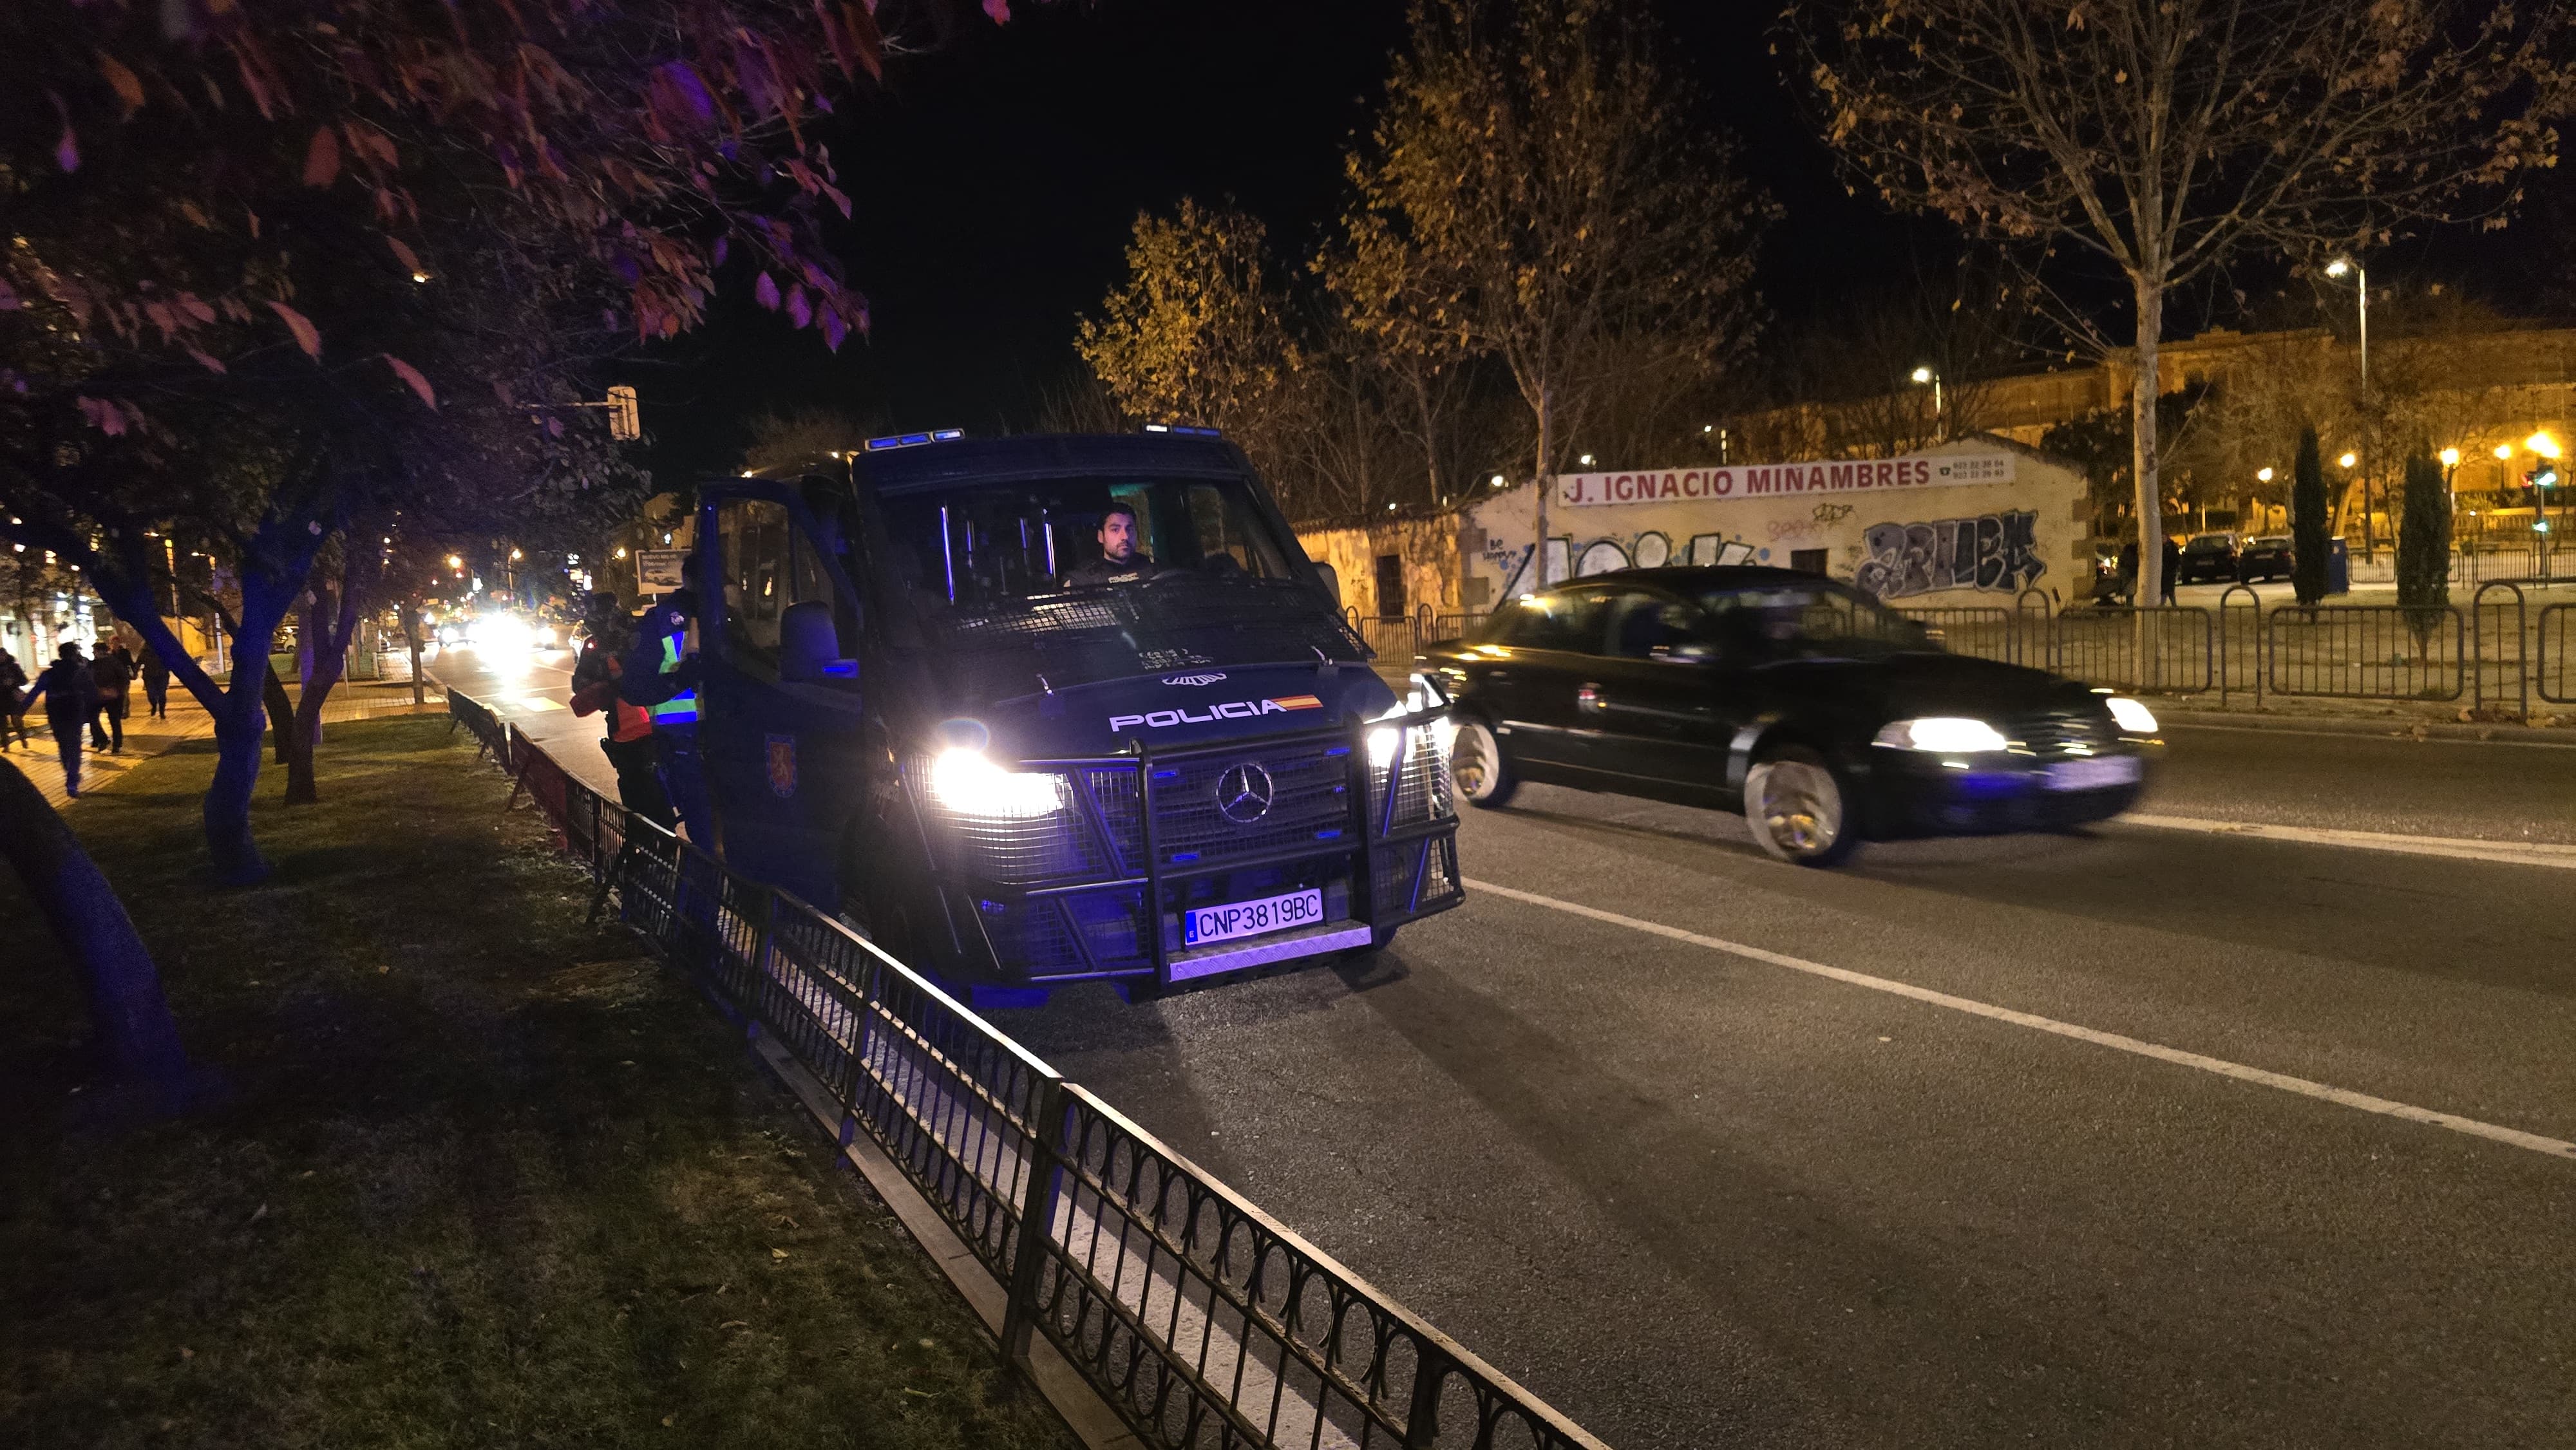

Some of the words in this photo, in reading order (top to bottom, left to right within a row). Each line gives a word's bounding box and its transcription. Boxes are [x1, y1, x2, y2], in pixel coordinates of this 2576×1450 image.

[1568, 477, 1593, 502] J.
[1604, 471, 1733, 501] IGNACIO
[1109, 699, 1287, 732] POLICIA
[1200, 894, 1318, 937] CNP3819BC
